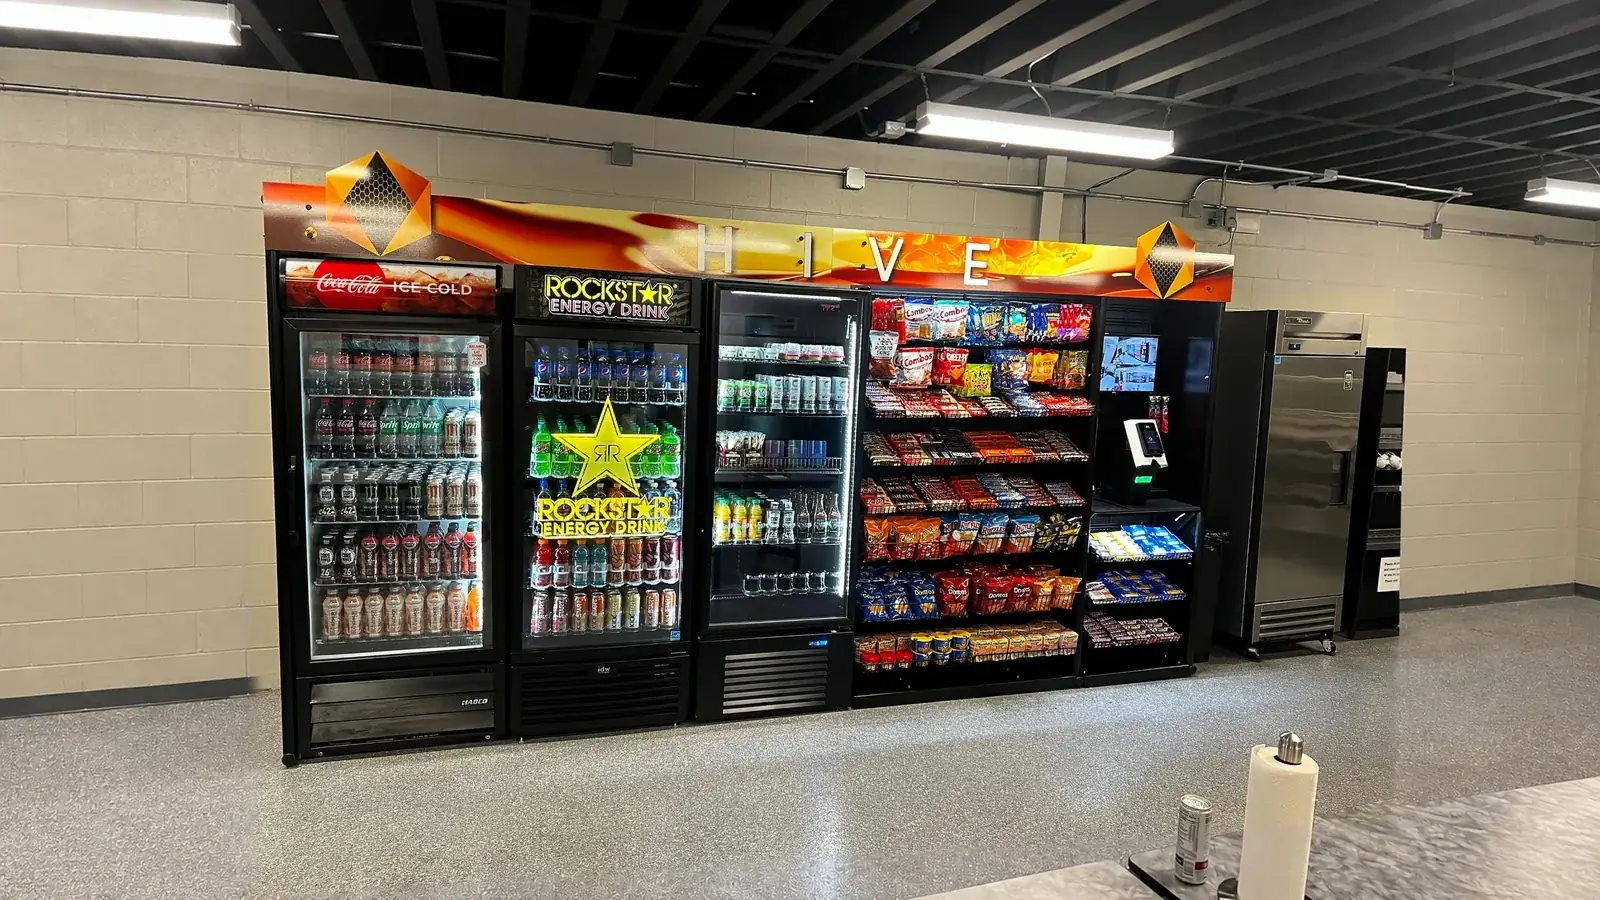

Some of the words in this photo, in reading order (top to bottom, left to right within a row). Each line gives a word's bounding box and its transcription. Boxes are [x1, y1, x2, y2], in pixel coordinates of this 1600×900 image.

[392, 281, 421, 294] ICE
[427, 283, 472, 296] COLD
[550, 299, 615, 315] ENERGY
[621, 303, 668, 319] DRINK
[906, 306, 932, 318] Combos
[903, 353, 933, 368] Combos
[543, 520, 610, 536] ENERGY
[615, 520, 665, 534] DRINK
